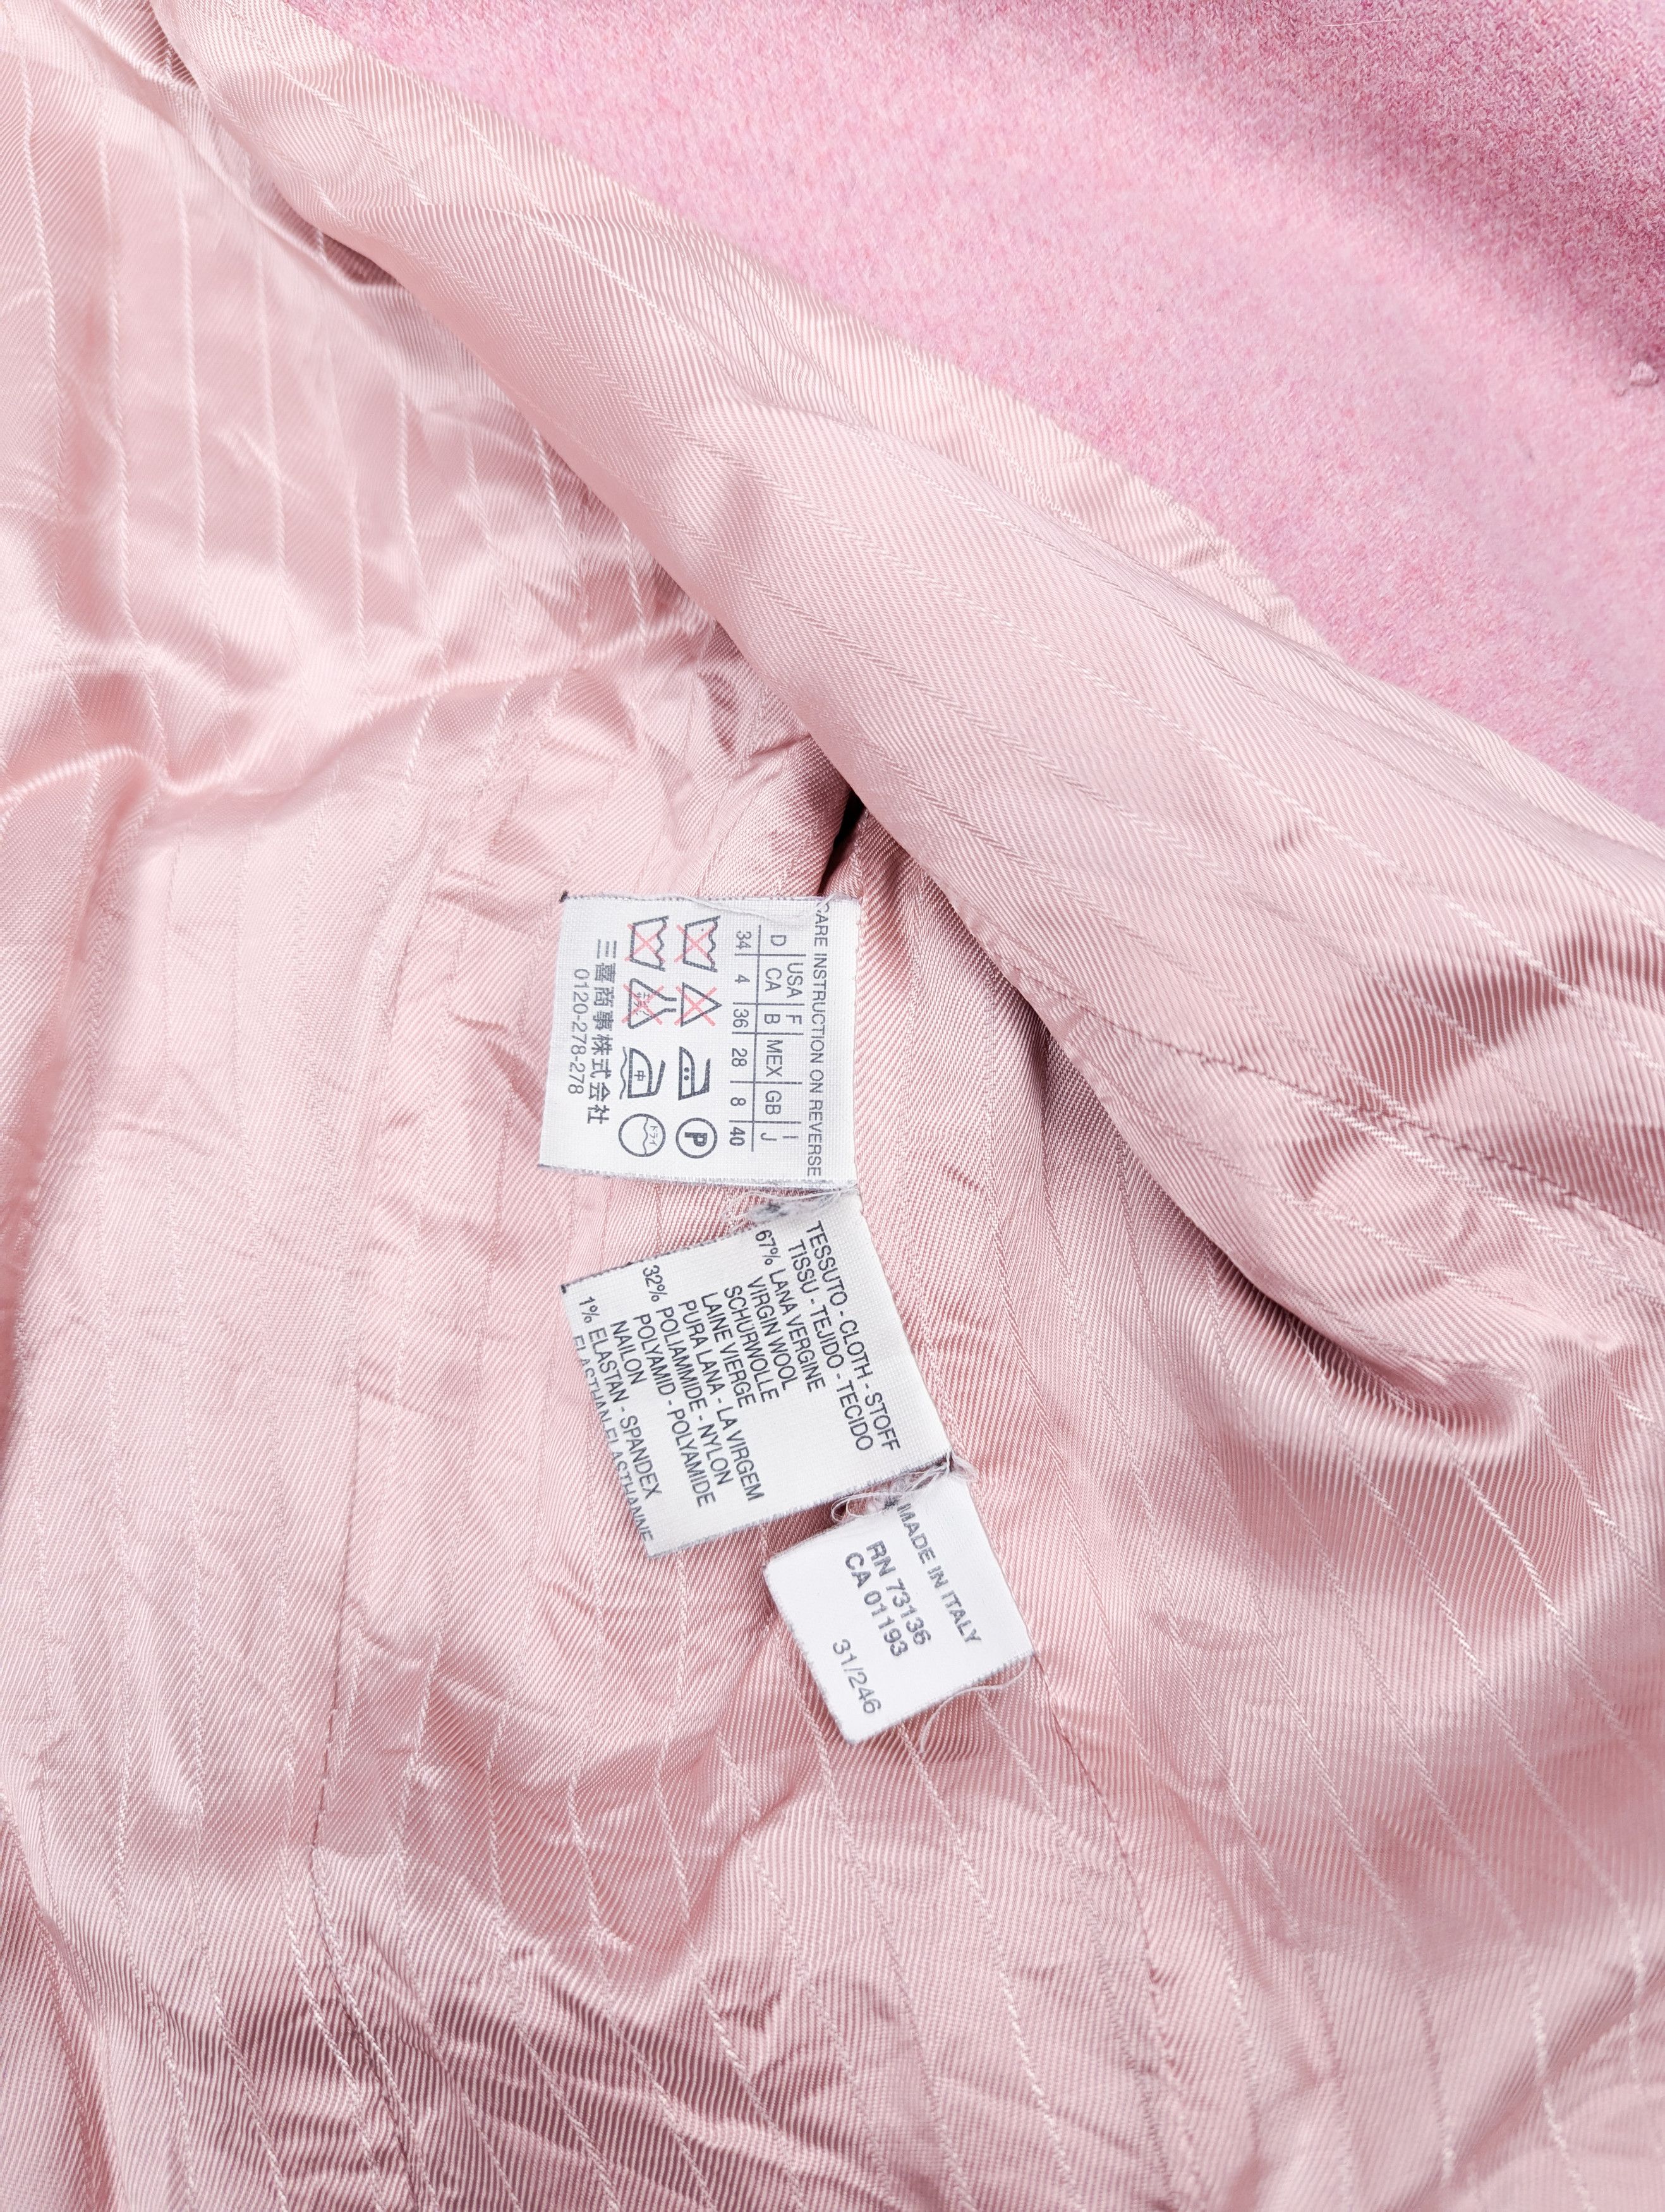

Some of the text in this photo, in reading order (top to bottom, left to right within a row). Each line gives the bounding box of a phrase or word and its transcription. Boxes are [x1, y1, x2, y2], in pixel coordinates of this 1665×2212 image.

[567, 968, 590, 1095] 0120-278-278
[586, 940, 617, 1125] 三喜商事株式会社
[785, 1014, 802, 1025] F
[786, 962, 804, 999] USA
[633, 1070, 646, 1081] 中
[729, 930, 753, 1146] 34 4 36 28 8 40
[760, 934, 787, 1141] D CA B MEX GB J
[807, 901, 830, 1177] CARE INSTRUCTION ON REVERSE
[684, 1131, 708, 1148] P
[579, 1296, 600, 1324] 1%
[642, 1265, 669, 1303] 32%
[677, 1299, 709, 1350] PURA
[747, 1275, 799, 1391] VIRGIN WOOL
[754, 1229, 826, 1393] 67% LANA VERGINE
[806, 1220, 848, 1306] TESSUTO
[839, 1319, 874, 1380] CLOTH
[864, 1392, 901, 1450] STOFF
[588, 1327, 630, 1404] ELASTAN
[610, 1320, 648, 1385] NAILON
[655, 1306, 708, 1413] POLIAMMIDE
[695, 1349, 726, 1395] LANA
[701, 1291, 757, 1409] LAINE VIERGE
[724, 1285, 780, 1403] SCHURWOLLE
[787, 1238, 820, 1294] TISSU
[809, 1304, 845, 1369] TEJIDO
[836, 1379, 874, 1451] TECIDO
[619, 1414, 663, 1500] SPANDEX
[633, 1313, 677, 1396] POLYAMID
[667, 1407, 717, 1508] POLYAMIDE
[697, 1423, 734, 1486] NYLON
[716, 1406, 739, 1431] LA
[726, 1429, 765, 1502] VIRGEM
[845, 1552, 909, 1658] CA 01193
[866, 1540, 931, 1645] RN 73136
[897, 1503, 982, 1643] MADE IN ITALY
[832, 1639, 882, 1714] 31/246
